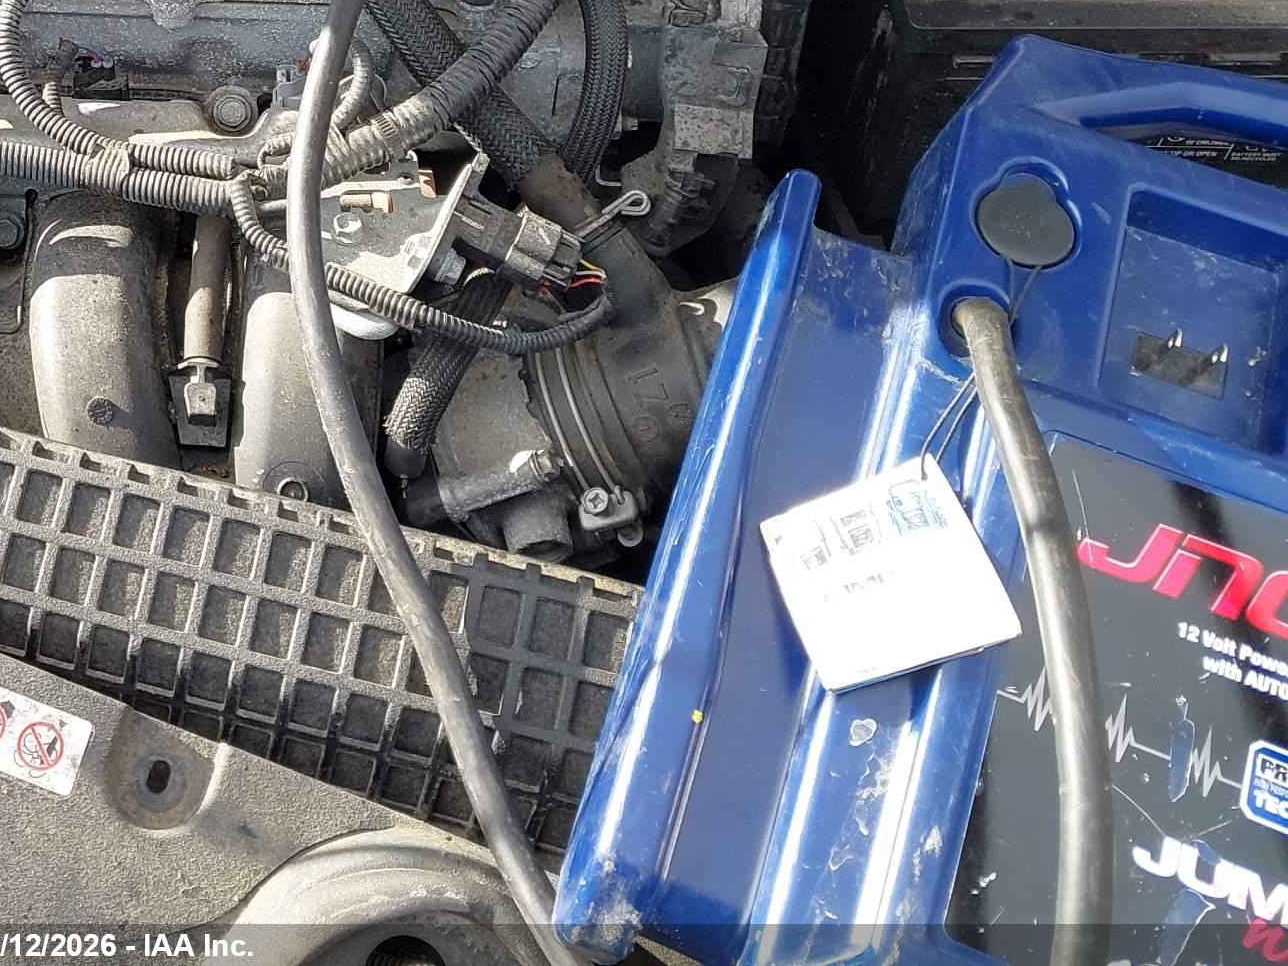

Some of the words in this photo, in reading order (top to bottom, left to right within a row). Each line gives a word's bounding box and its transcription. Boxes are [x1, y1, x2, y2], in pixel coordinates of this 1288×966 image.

[1178, 622, 1200, 642] 12
[1202, 629, 1237, 656] Volt
[1202, 656, 1243, 682] with
